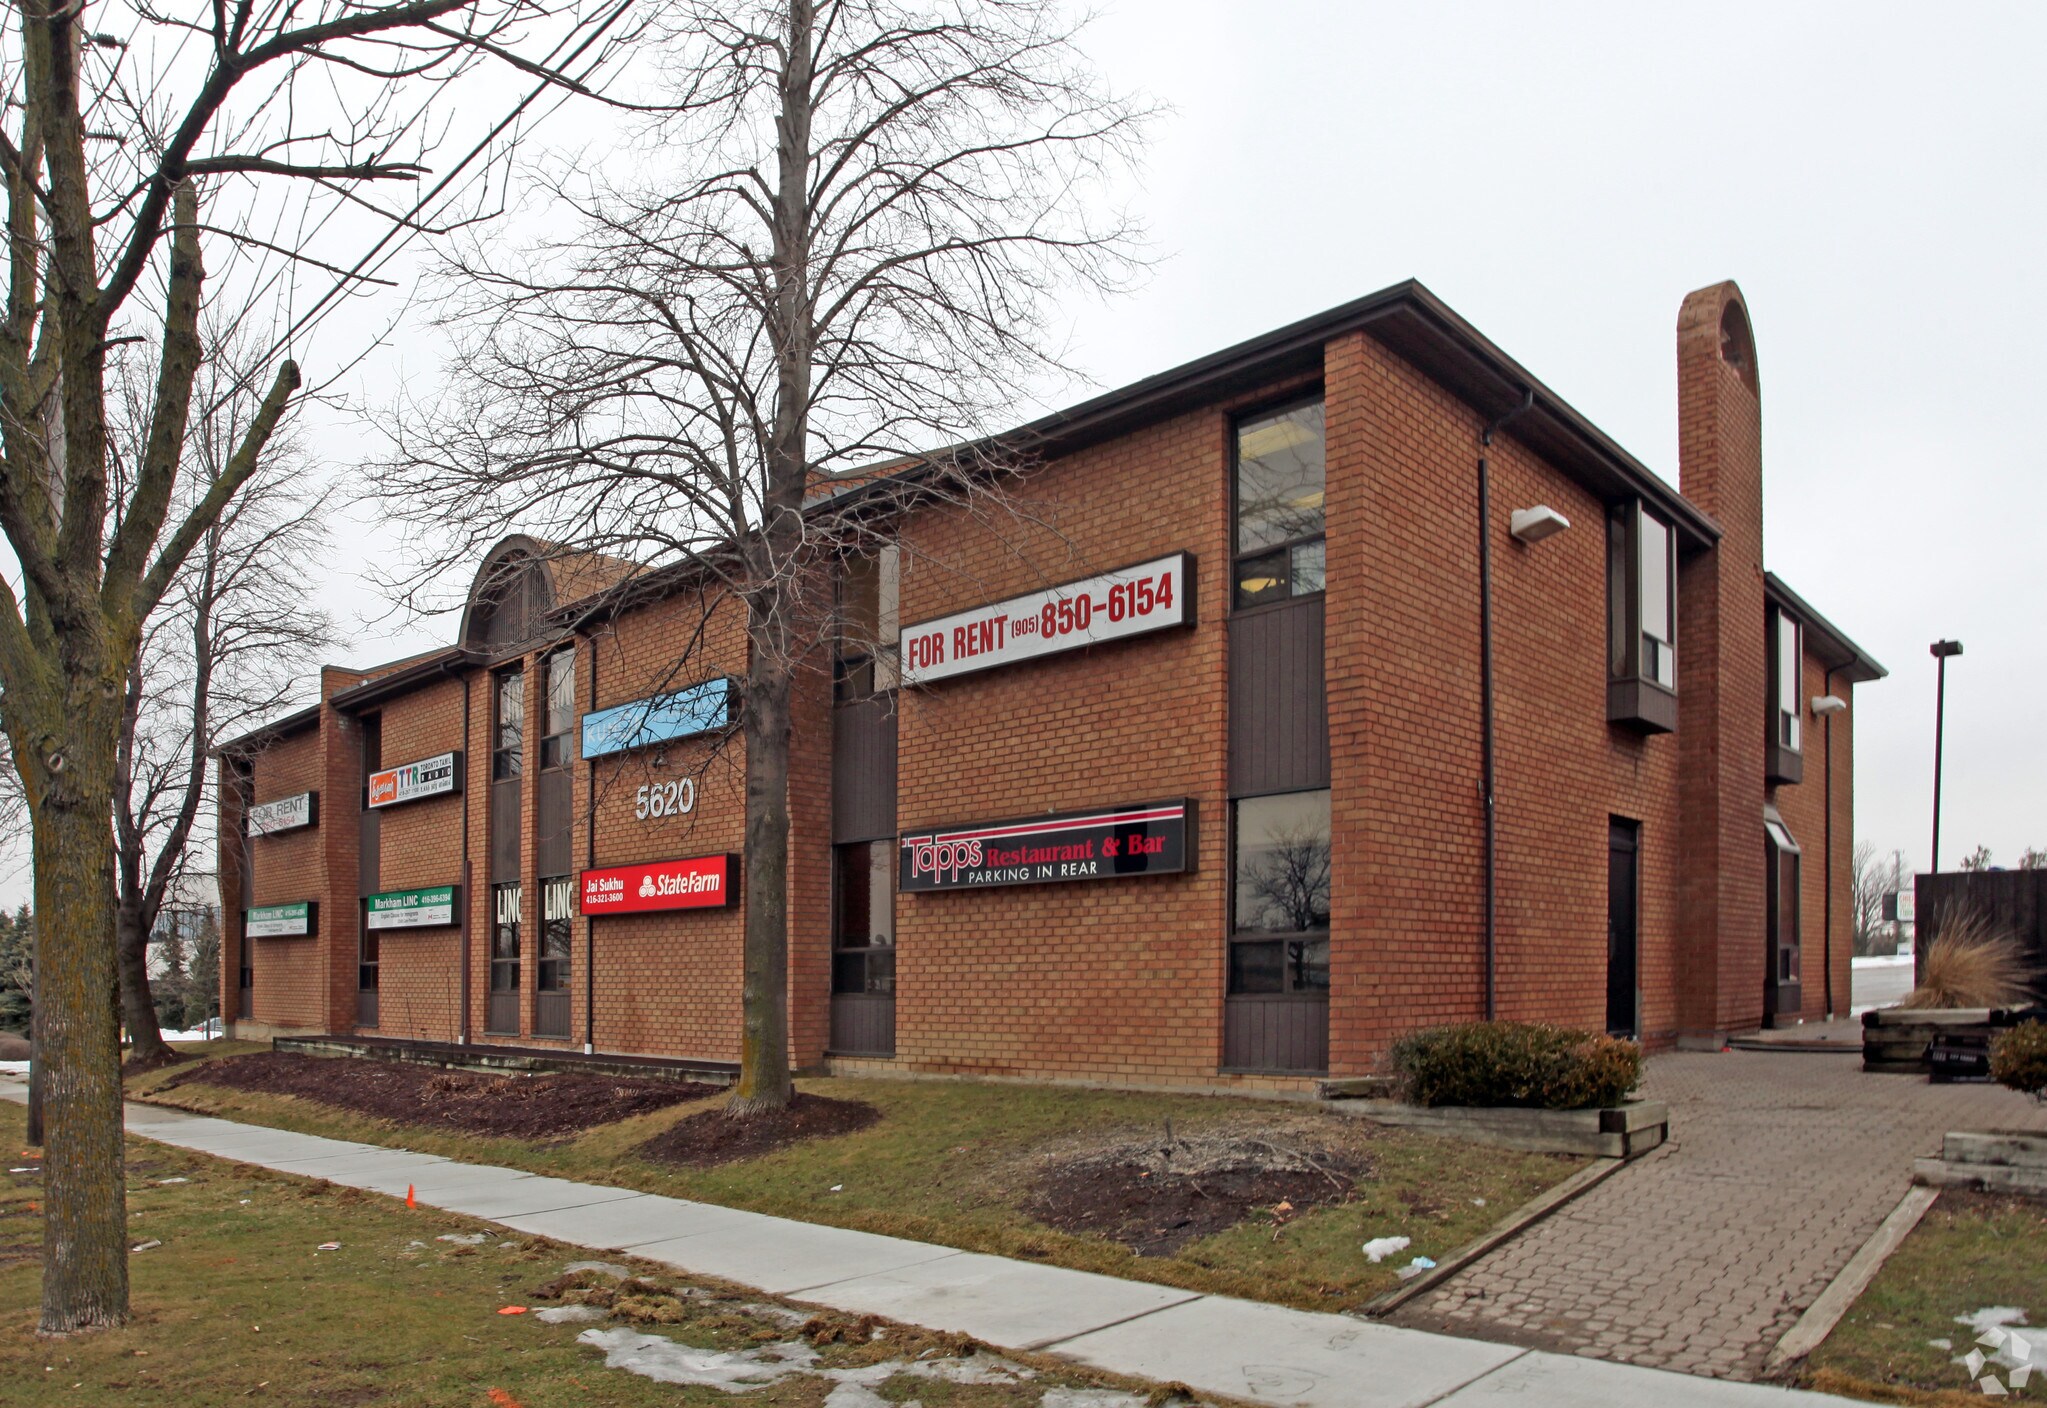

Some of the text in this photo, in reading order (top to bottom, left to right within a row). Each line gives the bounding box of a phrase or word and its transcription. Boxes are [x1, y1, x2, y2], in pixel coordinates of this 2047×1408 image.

[908, 571, 1173, 671] FOR RENT (905) 850-6154
[420, 760, 440, 772] TORONTO
[421, 767, 451, 781] RADIO
[398, 766, 419, 788] TTR
[276, 796, 304, 816] RENT
[635, 778, 695, 820] 5620
[910, 833, 1166, 884] Tapps Restaurant & Bar
[968, 861, 1098, 884] PARKING IN REAR
[586, 878, 598, 893] Jai
[599, 876, 624, 892] Sukhu
[374, 897, 402, 909] Markham
[403, 895, 418, 907] LINC
